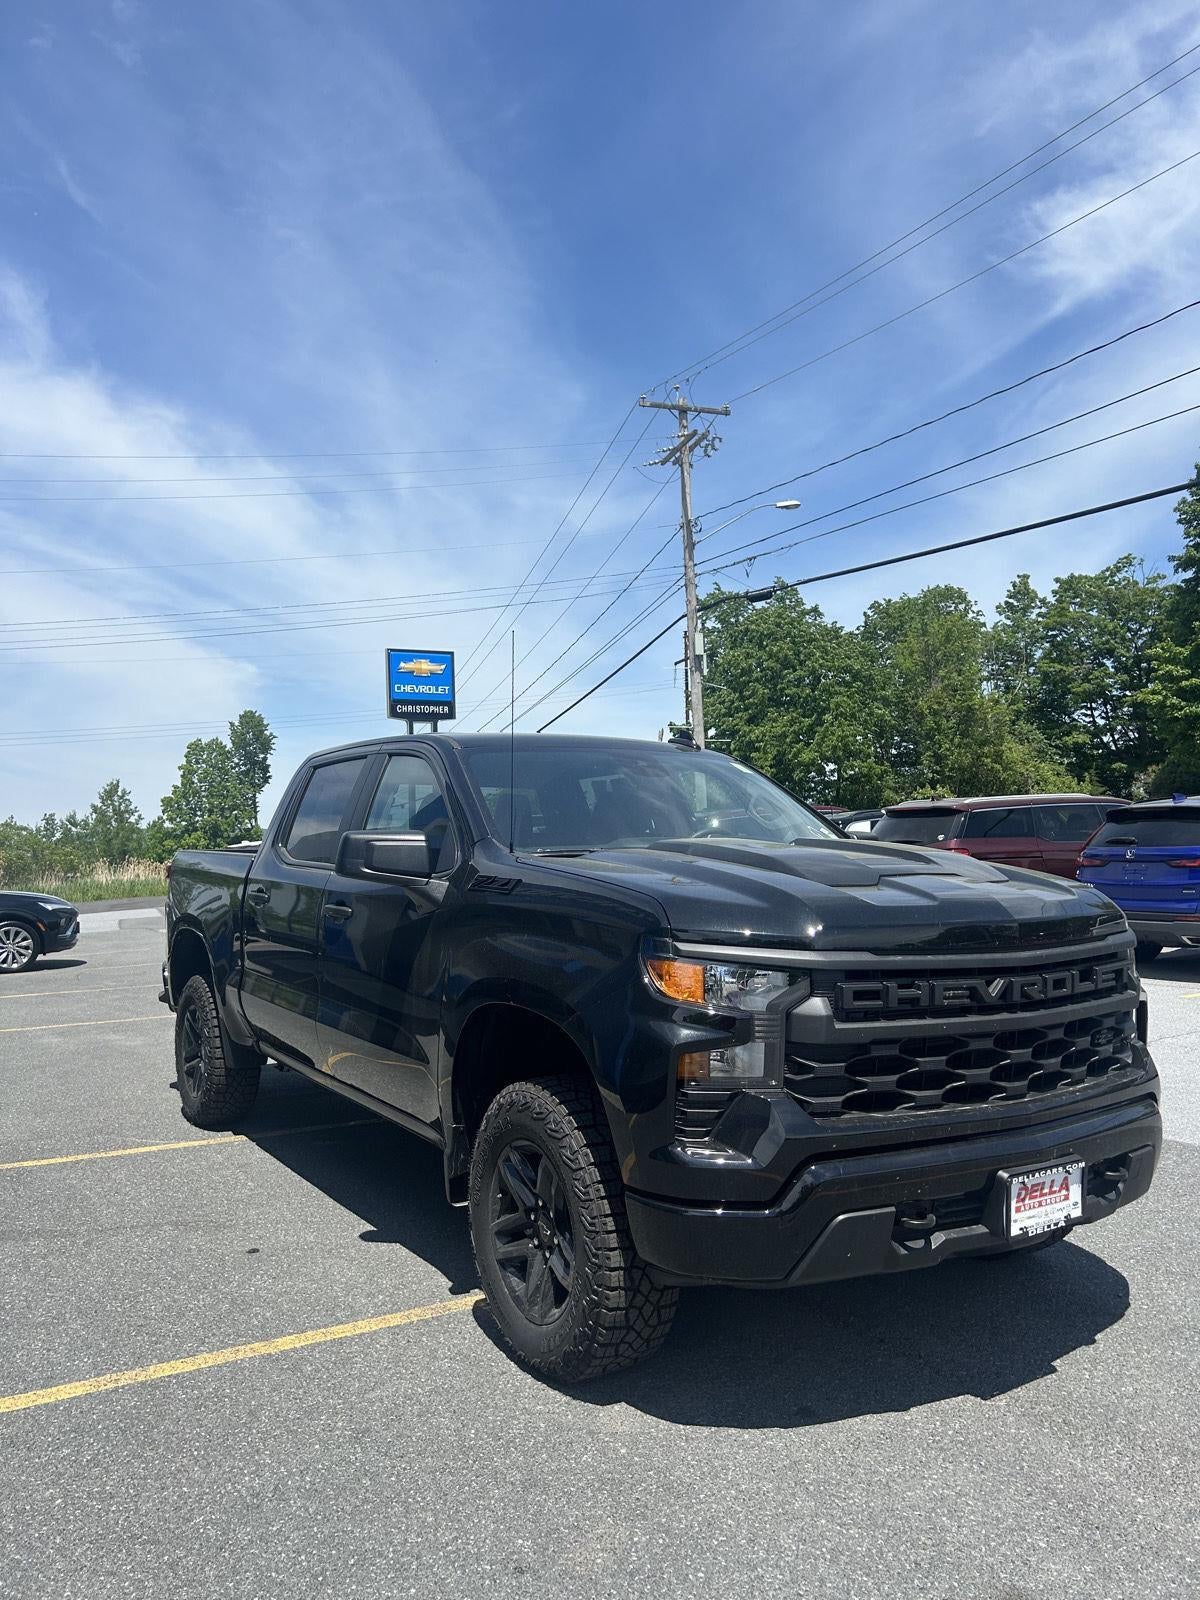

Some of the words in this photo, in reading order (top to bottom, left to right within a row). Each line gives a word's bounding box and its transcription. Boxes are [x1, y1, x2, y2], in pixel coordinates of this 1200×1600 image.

[394, 684, 450, 695] CHEVROLET
[396, 704, 449, 714] CHRISTOPHER
[1012, 1161, 1086, 1184] DELLACARS.COM
[1015, 1175, 1071, 1204] DELLA
[1020, 1202, 1040, 1212] AUTO
[1041, 1195, 1066, 1207] GROUP
[1028, 1220, 1067, 1237] DELLA
